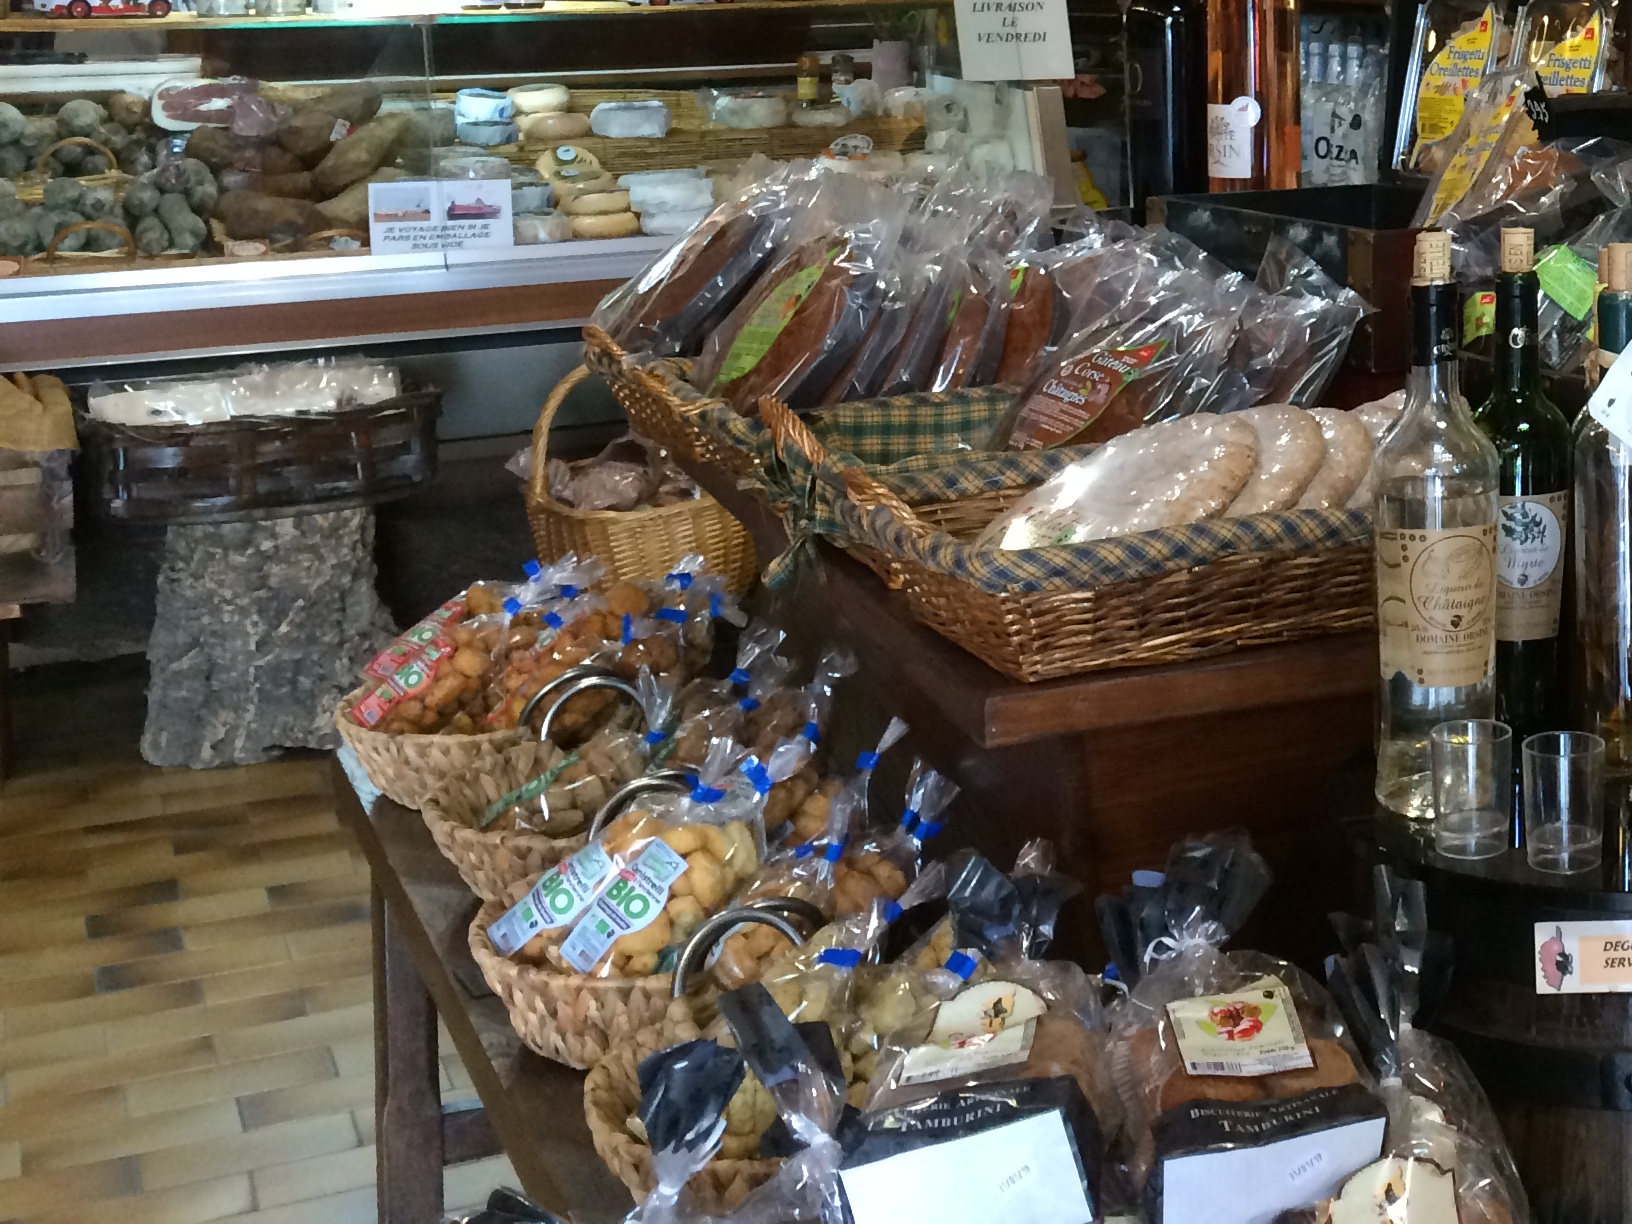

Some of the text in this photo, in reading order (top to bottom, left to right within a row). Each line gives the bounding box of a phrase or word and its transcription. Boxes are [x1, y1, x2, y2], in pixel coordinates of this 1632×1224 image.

[972, 1, 1045, 13] LIVRAISON
[1001, 16, 1018, 28] LE
[976, 32, 1047, 44] VENDREDI
[1545, 53, 1593, 72] Frisgetti
[1543, 73, 1587, 88] reillettes
[1074, 362, 1105, 381] Corse
[541, 872, 575, 916] BIO
[605, 877, 650, 920] BIO
[900, 1102, 1002, 1132] TAMBURINI
[1218, 1105, 1321, 1133] TAMBURINI
